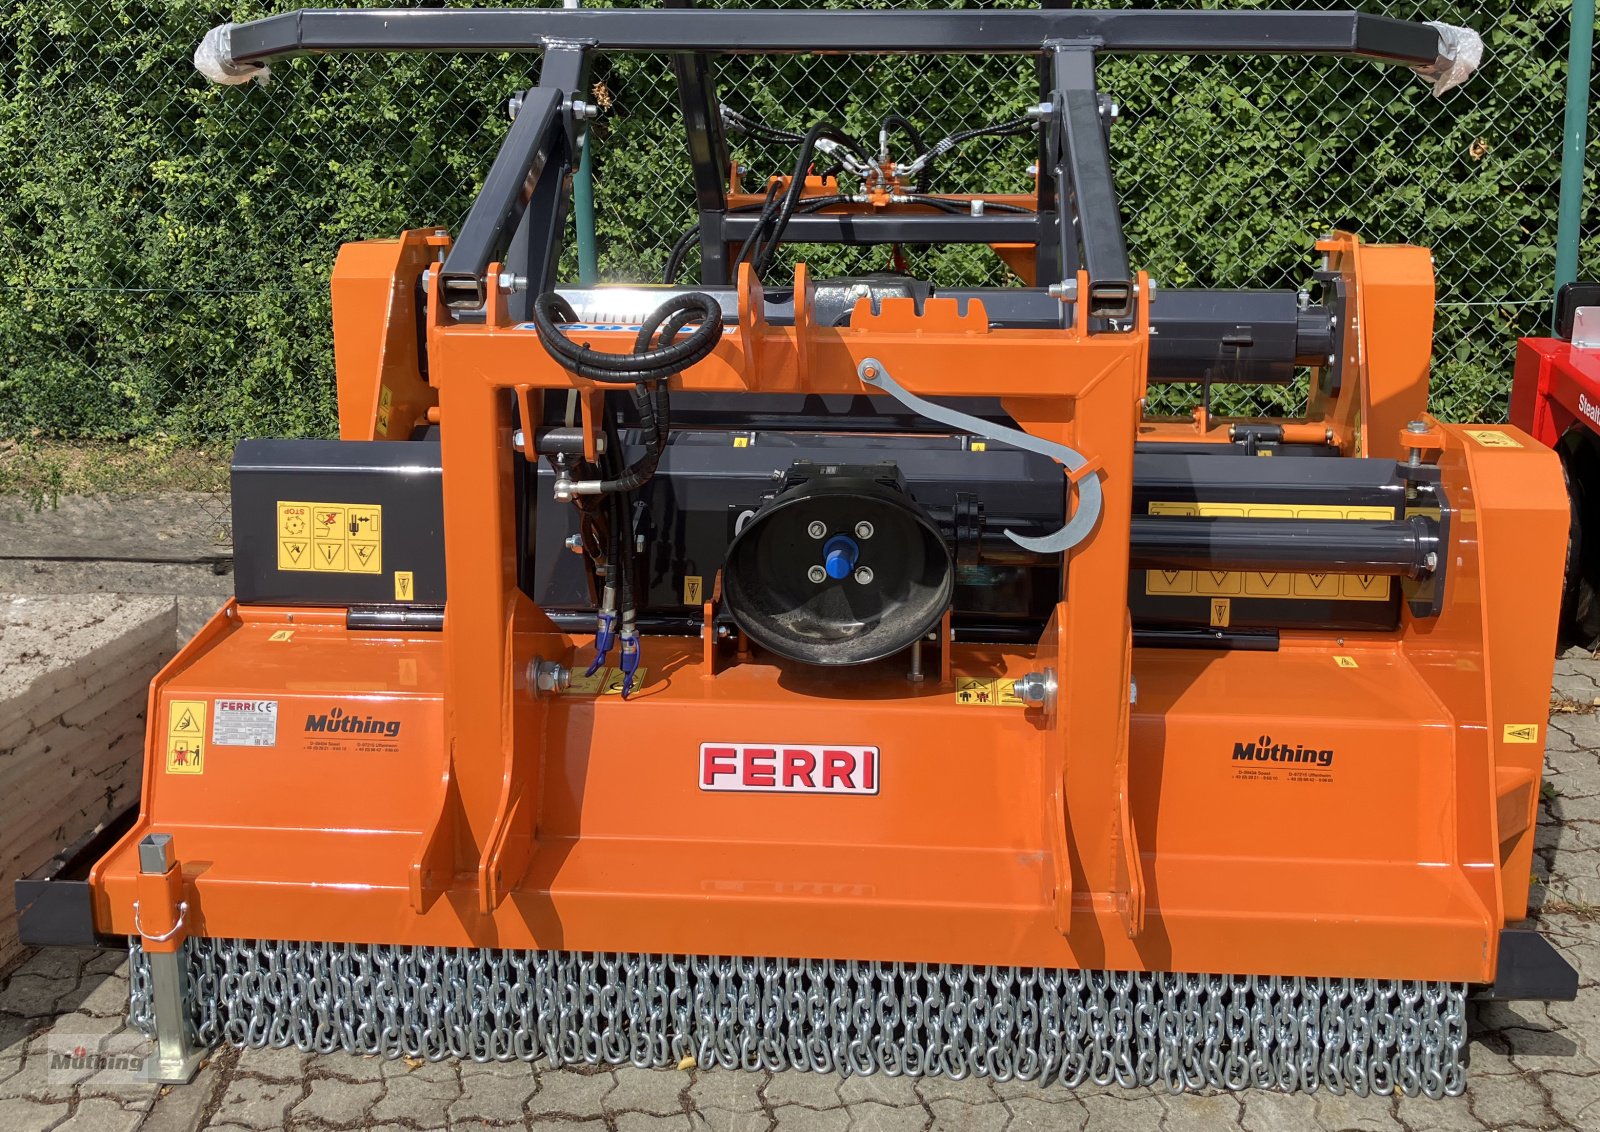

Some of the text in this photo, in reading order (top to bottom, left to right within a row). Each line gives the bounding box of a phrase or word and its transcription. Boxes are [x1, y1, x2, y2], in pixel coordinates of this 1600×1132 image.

[221, 702, 256, 711] FERRI
[305, 707, 400, 737] Müthing
[1232, 735, 1333, 767] Müthing
[703, 747, 875, 790] FERRI
